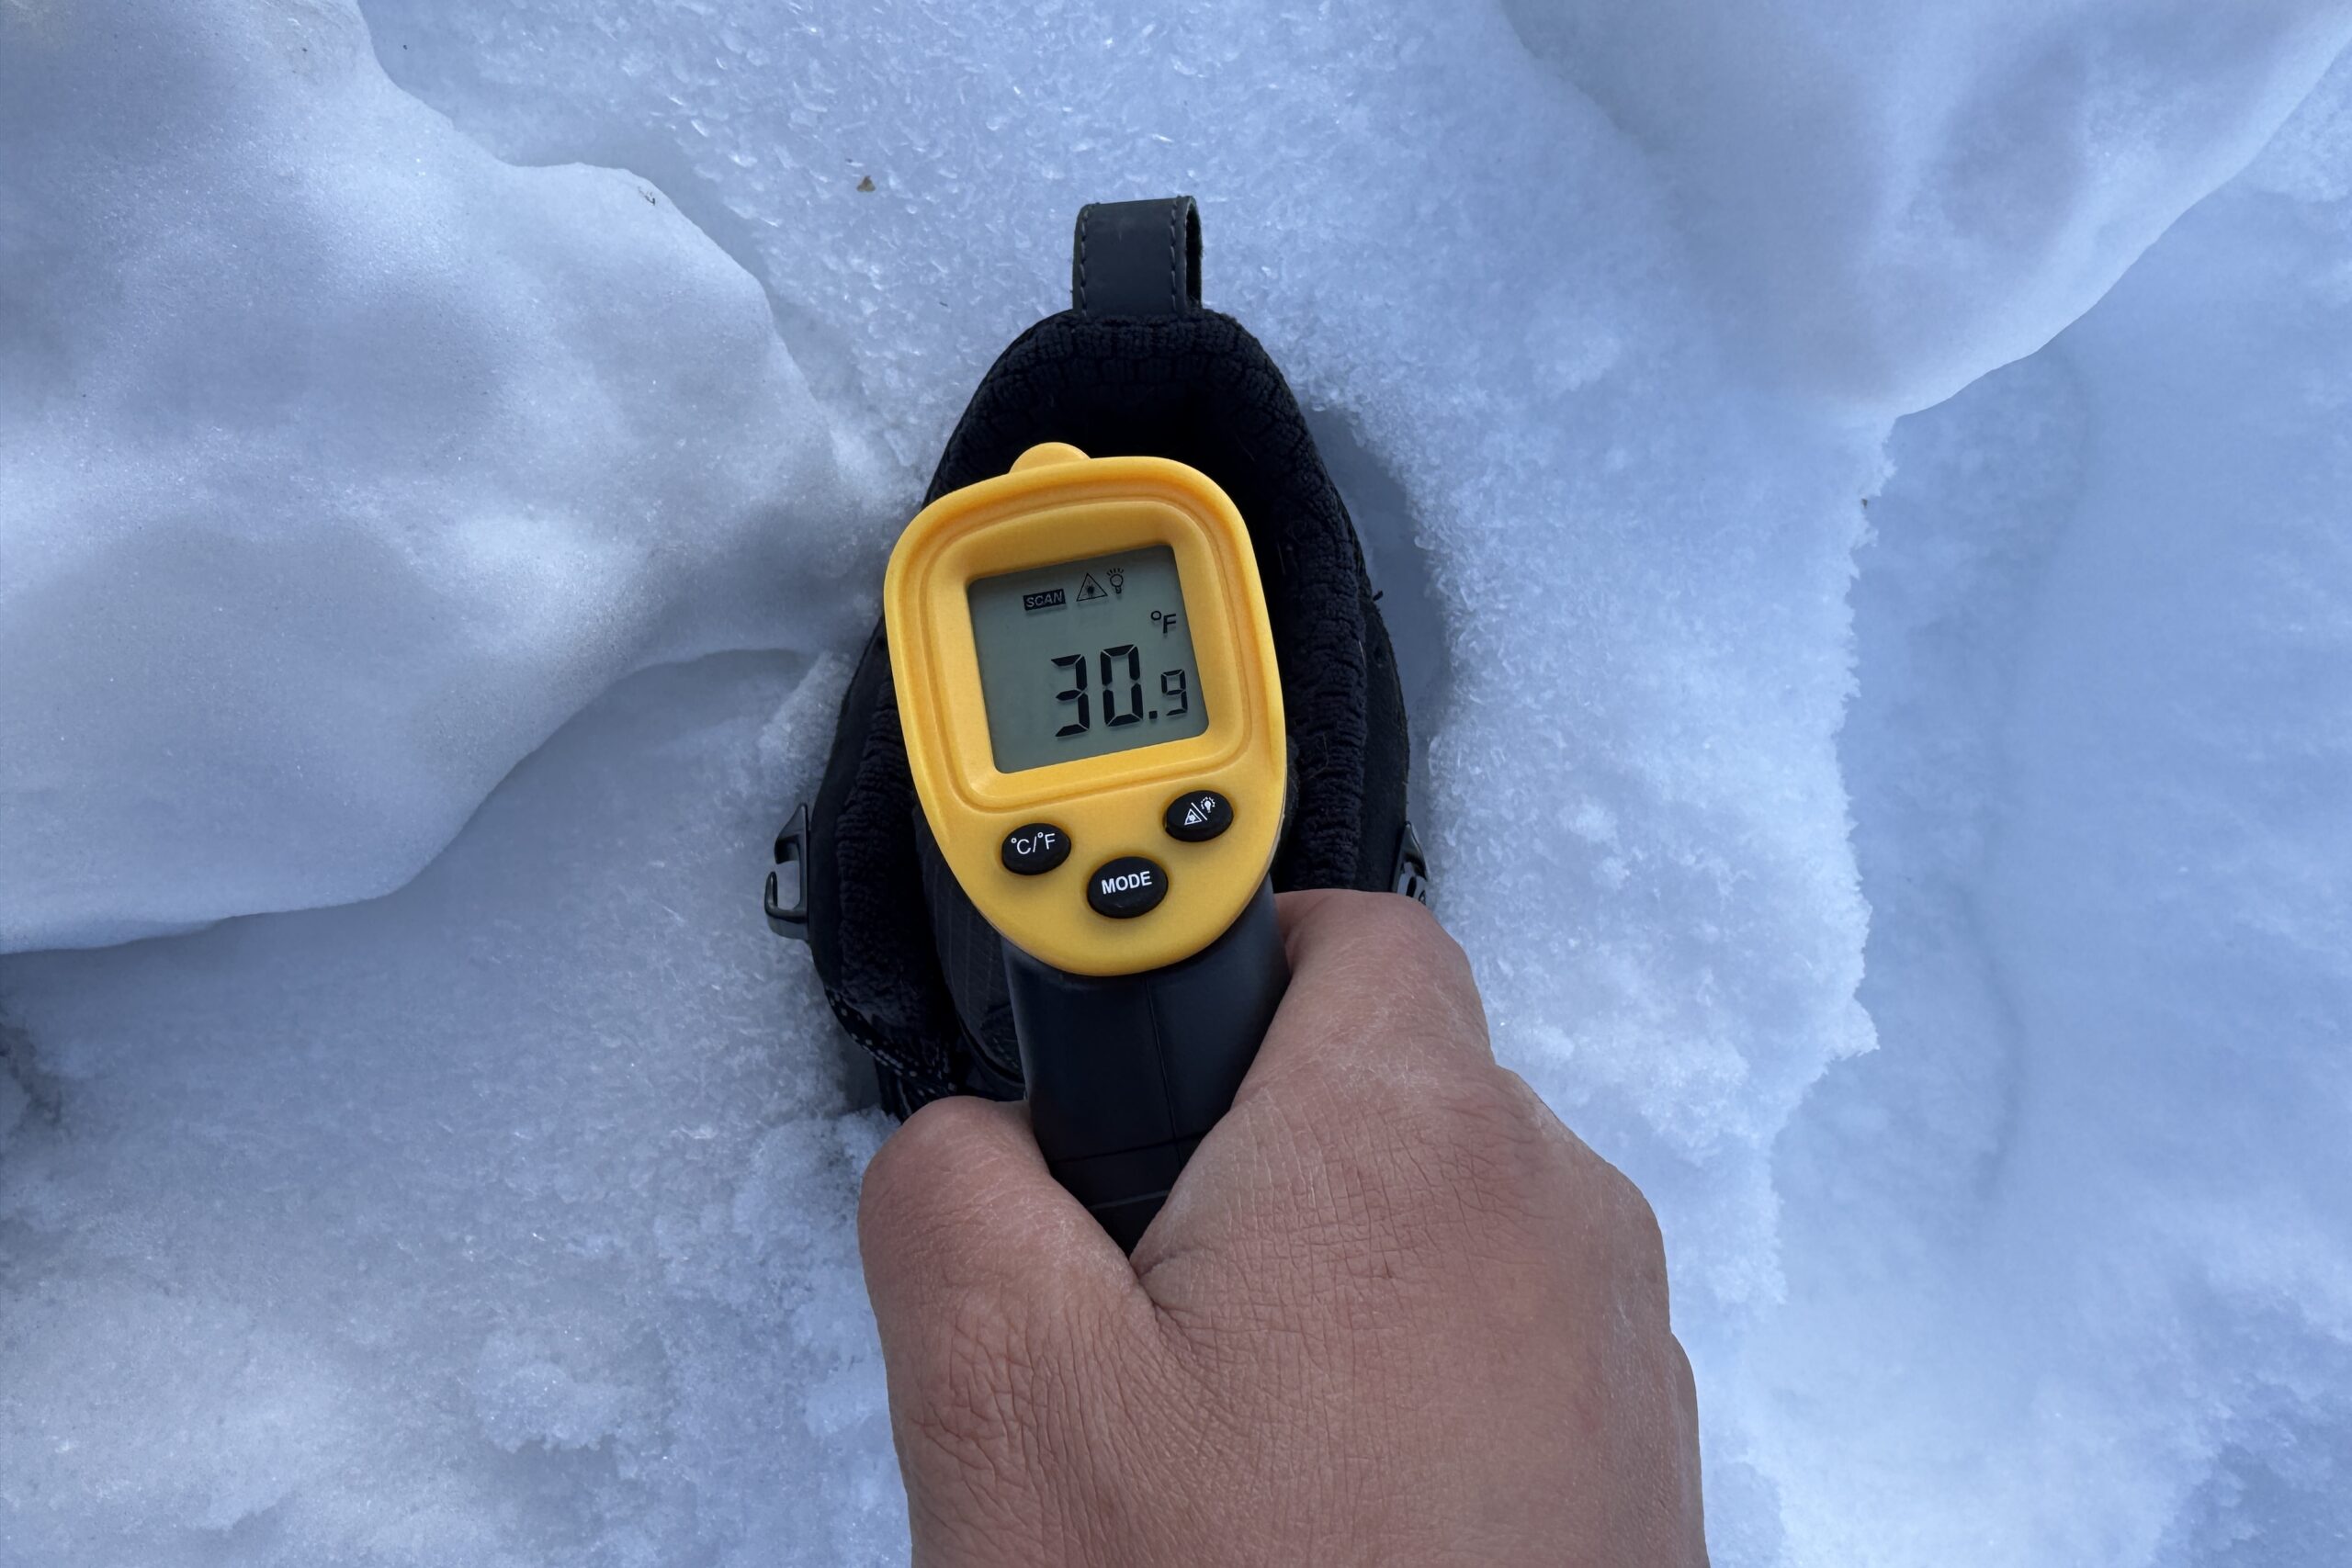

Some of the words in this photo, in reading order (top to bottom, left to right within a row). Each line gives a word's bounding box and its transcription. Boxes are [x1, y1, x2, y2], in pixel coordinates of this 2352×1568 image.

[1025, 592, 1064, 609] SCAN
[1150, 610, 1177, 634] °F
[1050, 644, 1189, 737] 30.9
[1011, 831, 1056, 855] °C/°F
[1101, 870, 1153, 895] MODE
